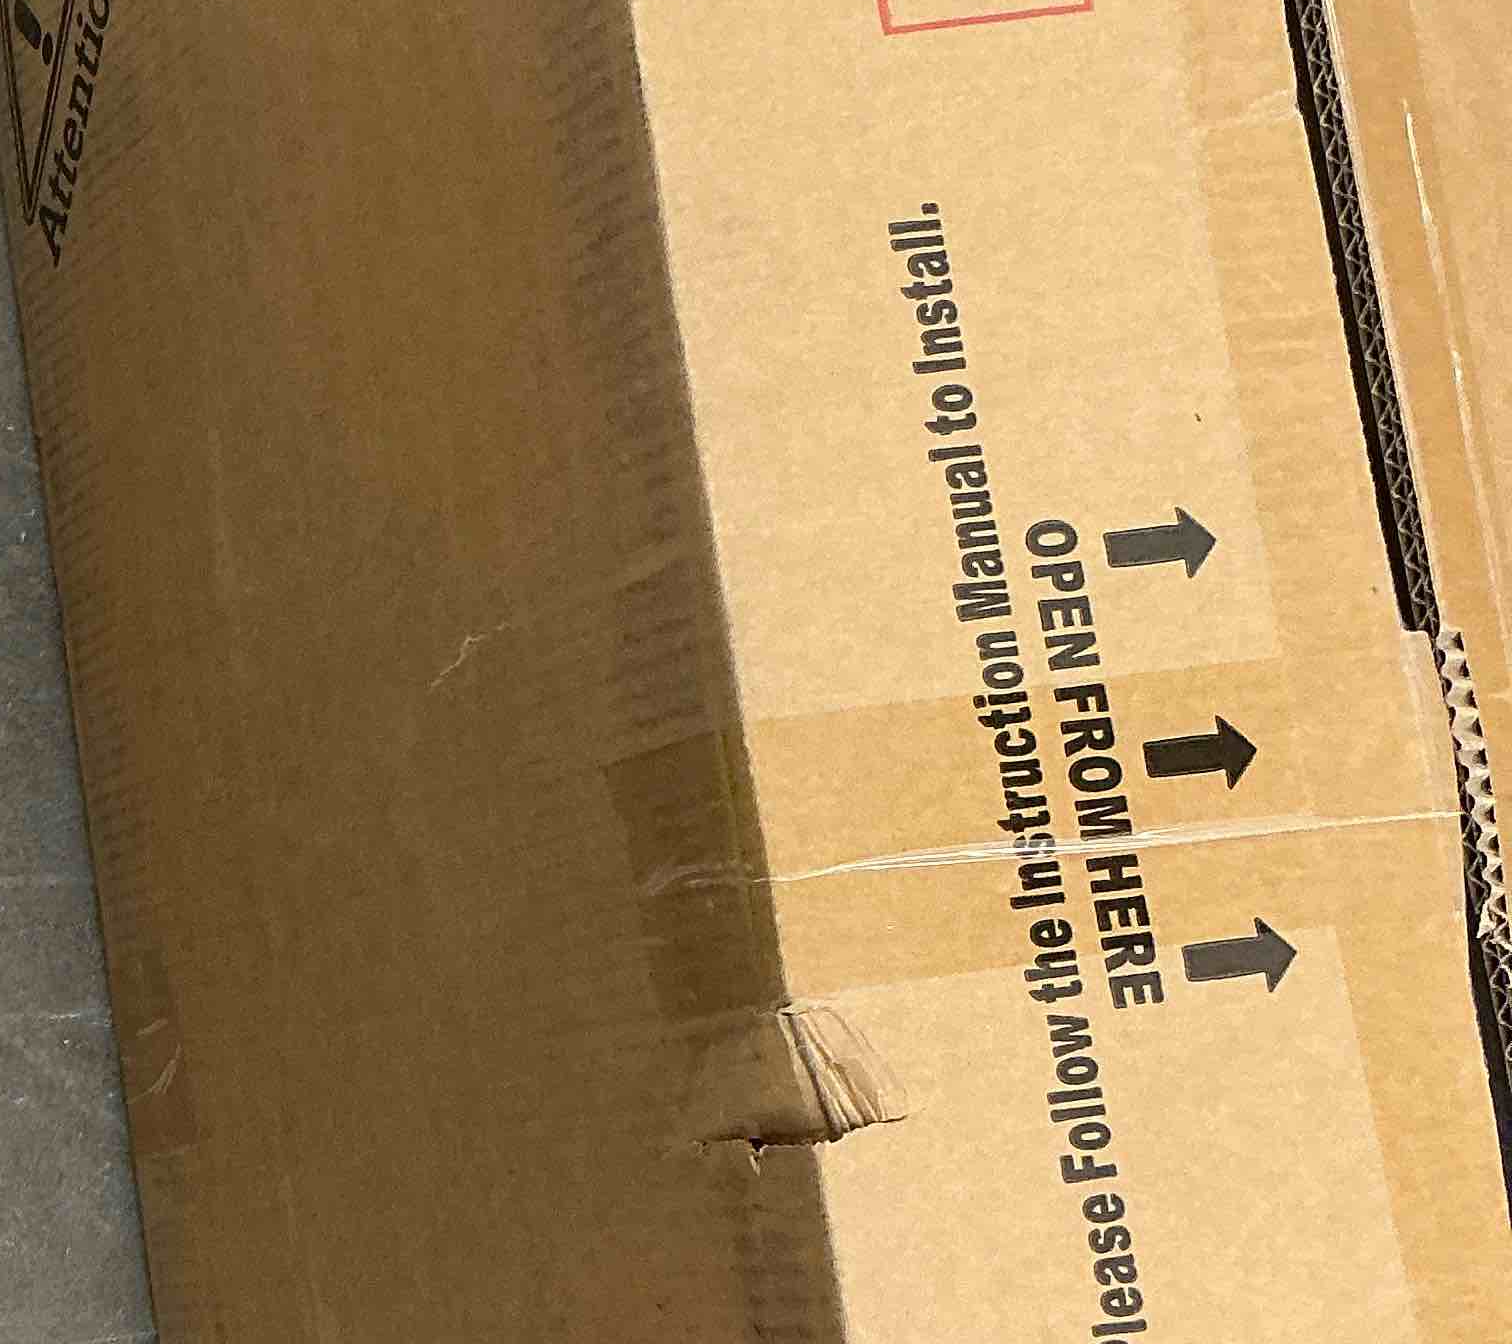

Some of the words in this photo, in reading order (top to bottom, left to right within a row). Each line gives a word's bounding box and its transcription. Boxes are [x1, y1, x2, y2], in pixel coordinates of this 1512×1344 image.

[888, 202, 967, 374] Install.
[925, 384, 977, 435] to
[928, 444, 1013, 622] Manual
[1025, 519, 1100, 671] OPEN
[973, 631, 1067, 909] Instruction
[1054, 683, 1133, 841] FROM
[1024, 918, 1083, 1004] the
[1085, 853, 1165, 1009] HERE
[1047, 1014, 1119, 1184] Follow
